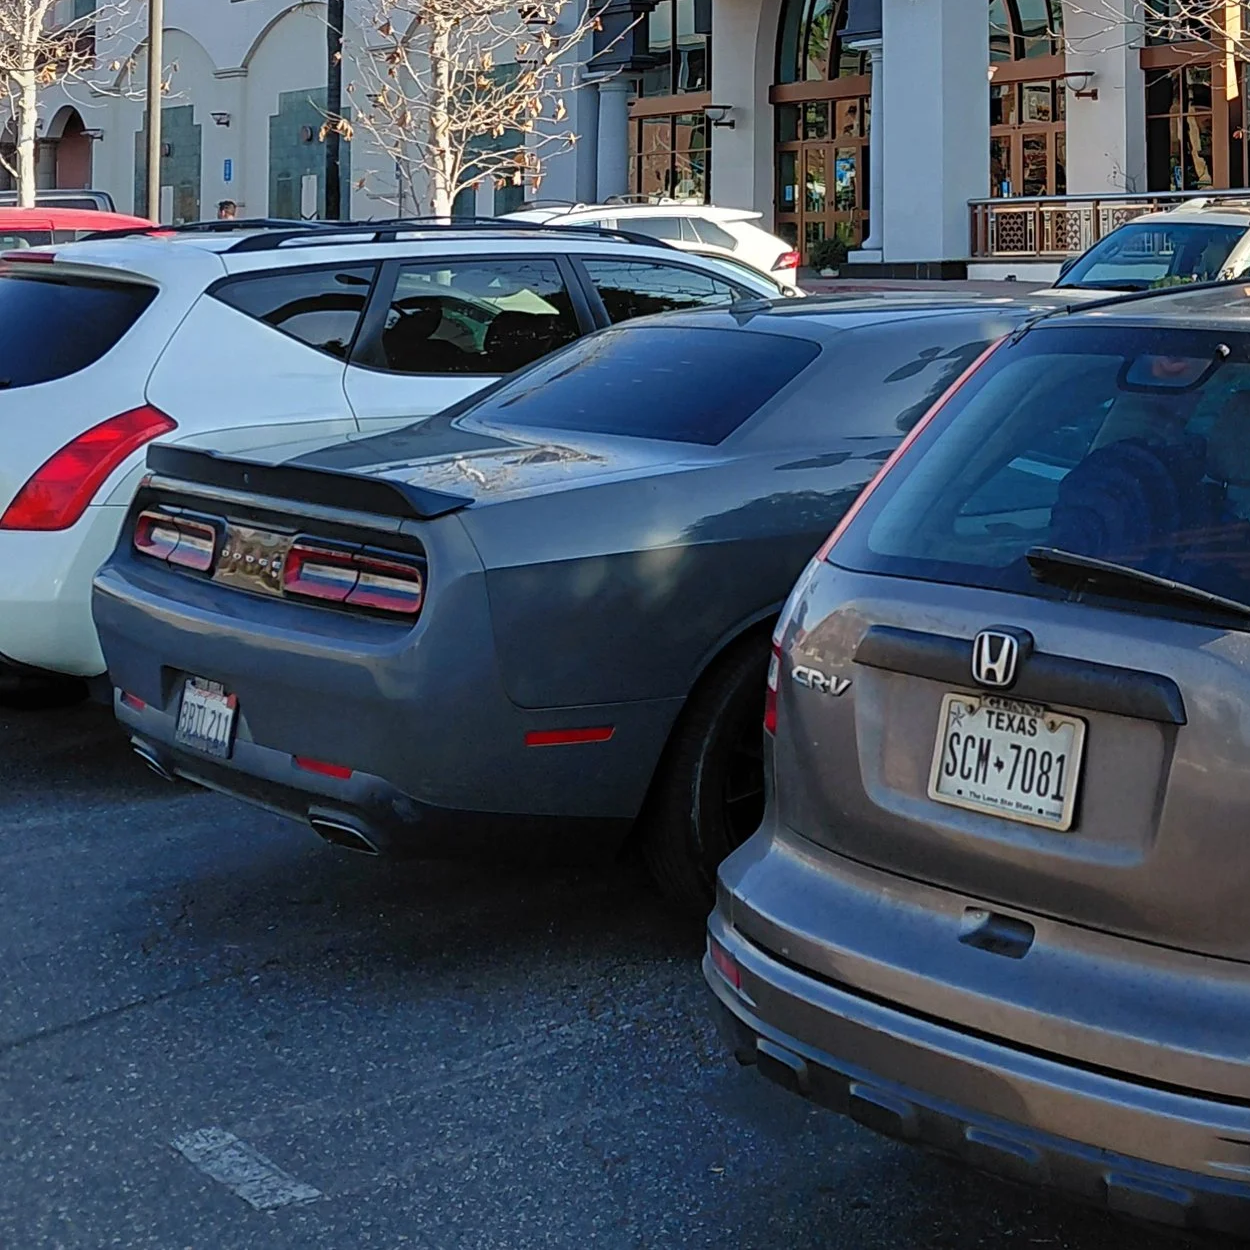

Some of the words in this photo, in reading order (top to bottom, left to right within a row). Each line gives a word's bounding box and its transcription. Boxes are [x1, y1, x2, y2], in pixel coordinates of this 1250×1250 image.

[222, 550, 281, 569] DODGE
[792, 665, 852, 697] CR-V
[985, 709, 1038, 737] TEXAS
